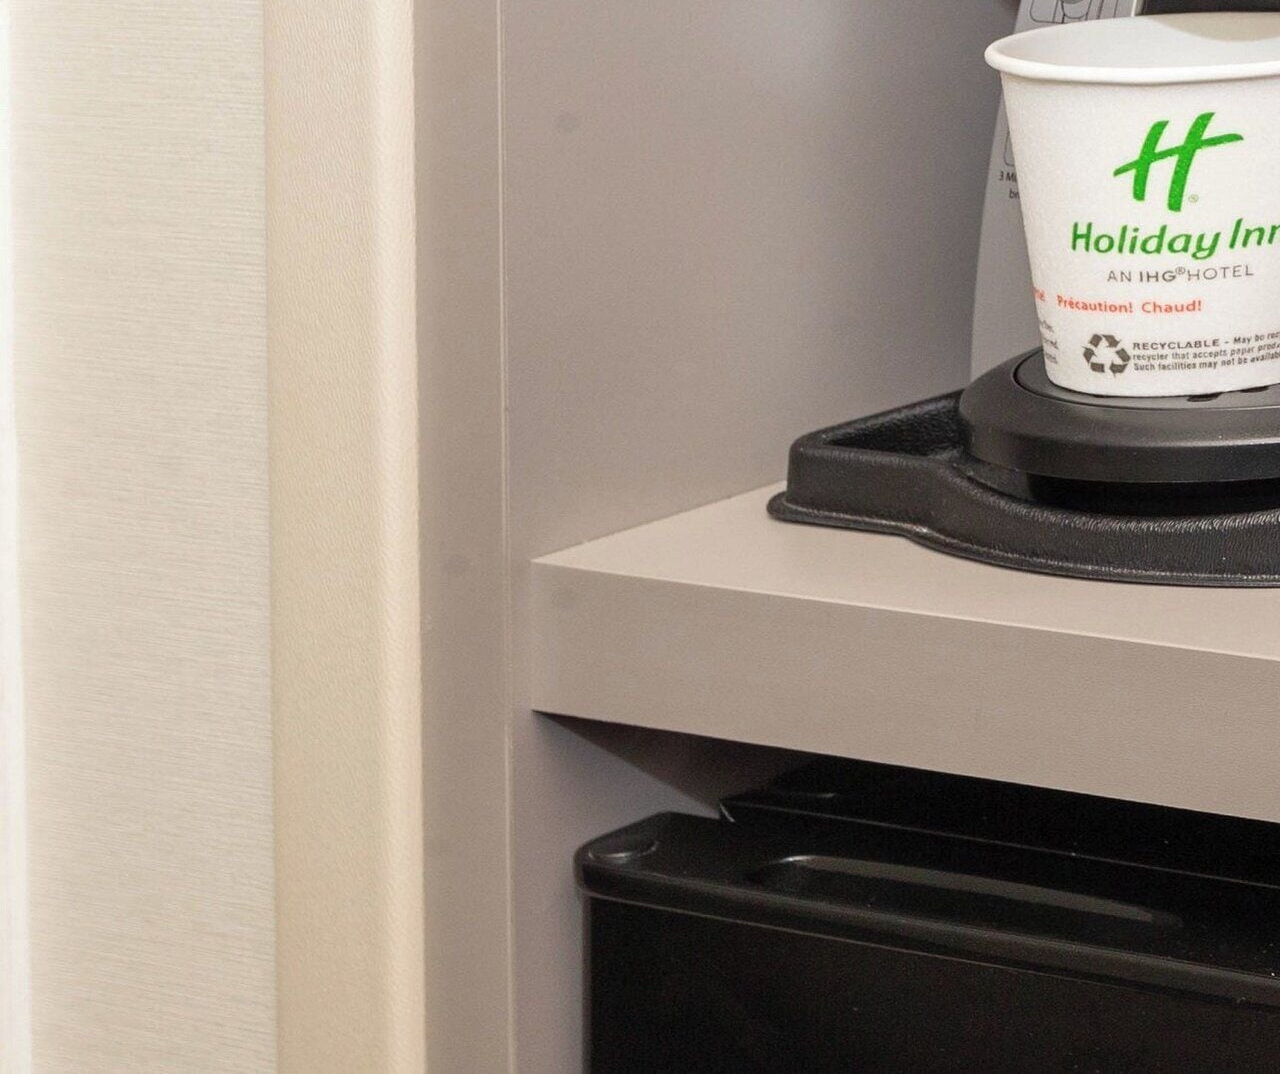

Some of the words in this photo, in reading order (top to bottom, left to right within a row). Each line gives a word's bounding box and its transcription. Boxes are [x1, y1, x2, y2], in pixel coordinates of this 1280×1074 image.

[1071, 221, 1221, 260] Holiday
[1107, 269, 1132, 283] AN
[1187, 264, 1254, 281] HOTEL
[1056, 294, 1134, 313] Précaution!
[1141, 300, 1202, 313] Chaud!
[1132, 338, 1220, 351] RECYCLABLE
